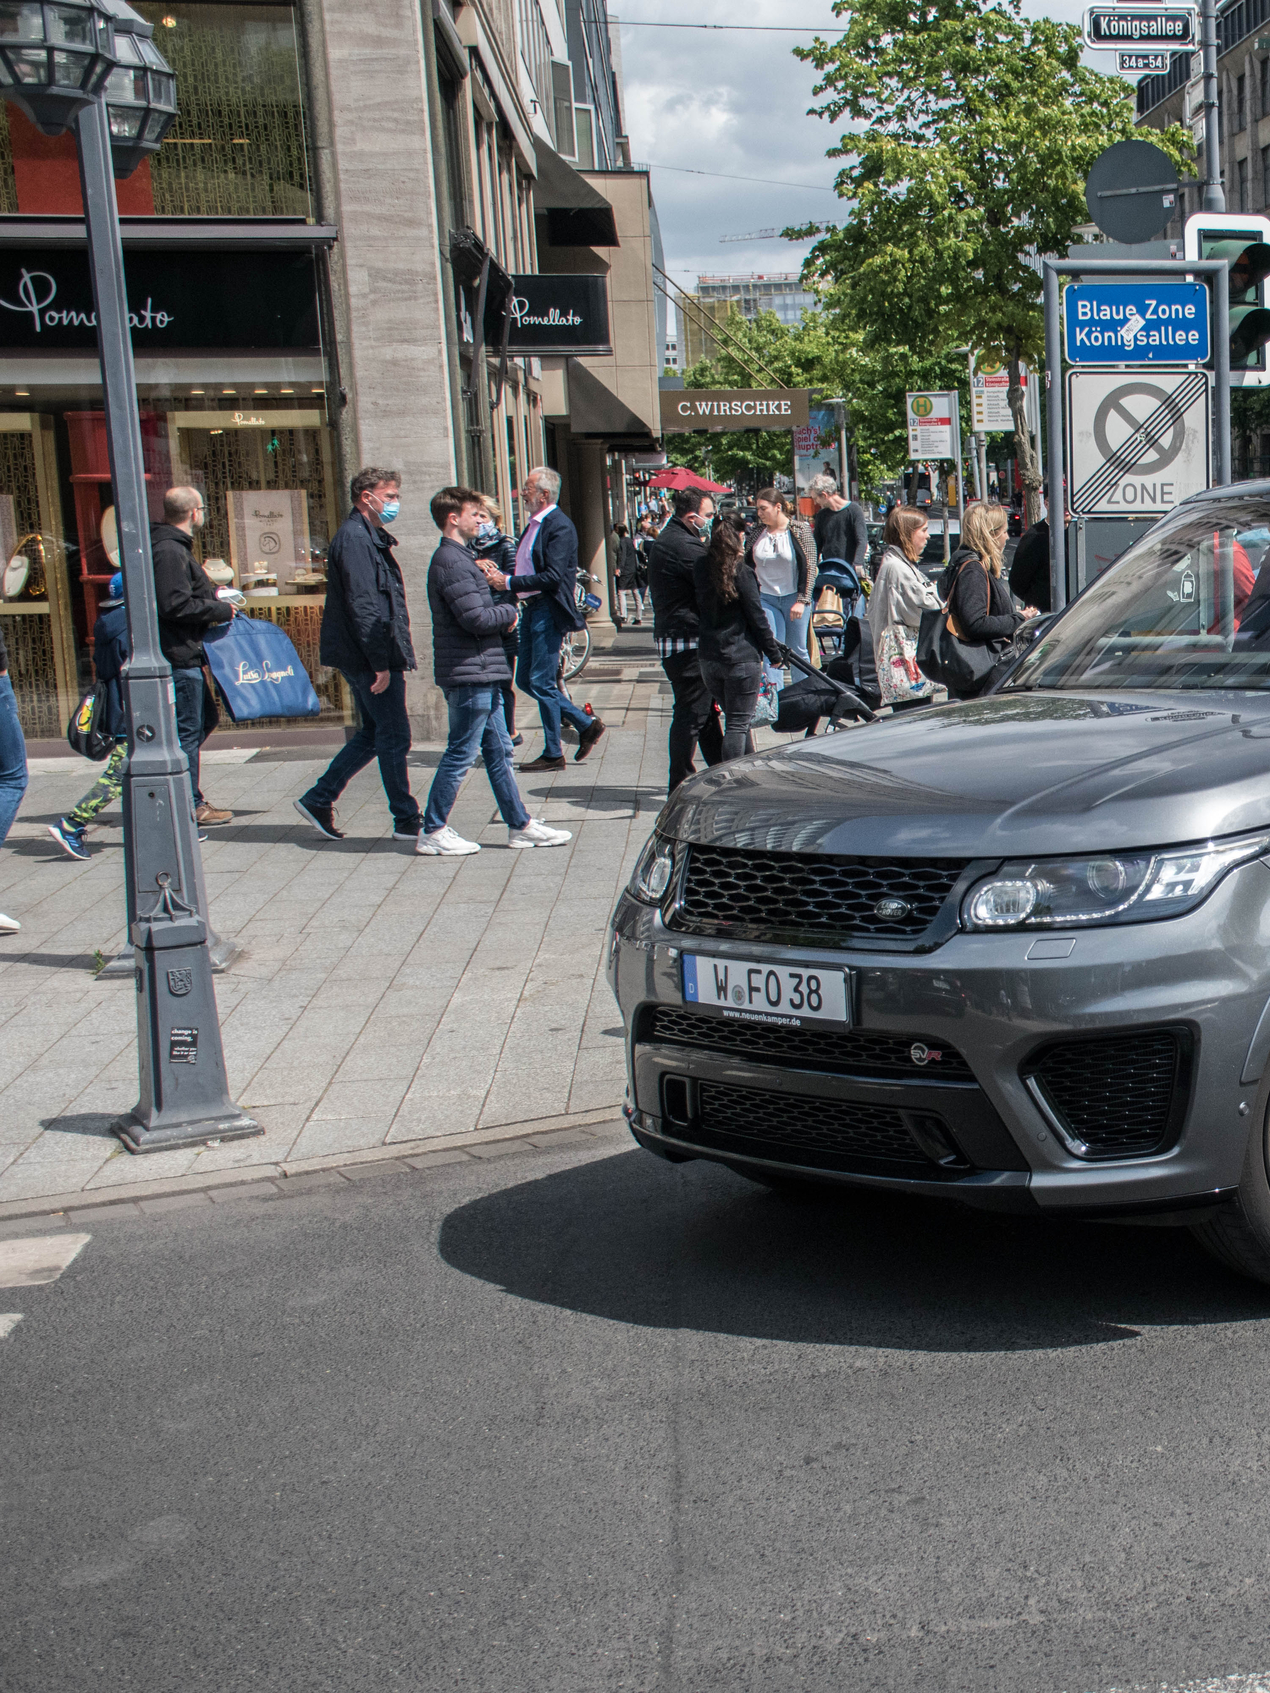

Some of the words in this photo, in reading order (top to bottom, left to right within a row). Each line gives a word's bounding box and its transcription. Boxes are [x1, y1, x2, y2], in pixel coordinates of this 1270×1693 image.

[1100, 16, 1183, 39] Königsallee
[1122, 55, 1163, 69] 34a-54
[502, 296, 583, 328] Pomellato
[1078, 300, 1137, 320] Blaue
[1145, 300, 1196, 319] Zone
[1075, 326, 1199, 351] Königsallee
[973, 377, 984, 387] 12
[677, 401, 792, 416] C.WIRSCHKE
[1106, 483, 1174, 504] ZONE
[713, 963, 729, 1001] W
[747, 968, 782, 1007] FO
[788, 972, 823, 1012] 38
[723, 1009, 801, 1026] www.neuenkamper.de
